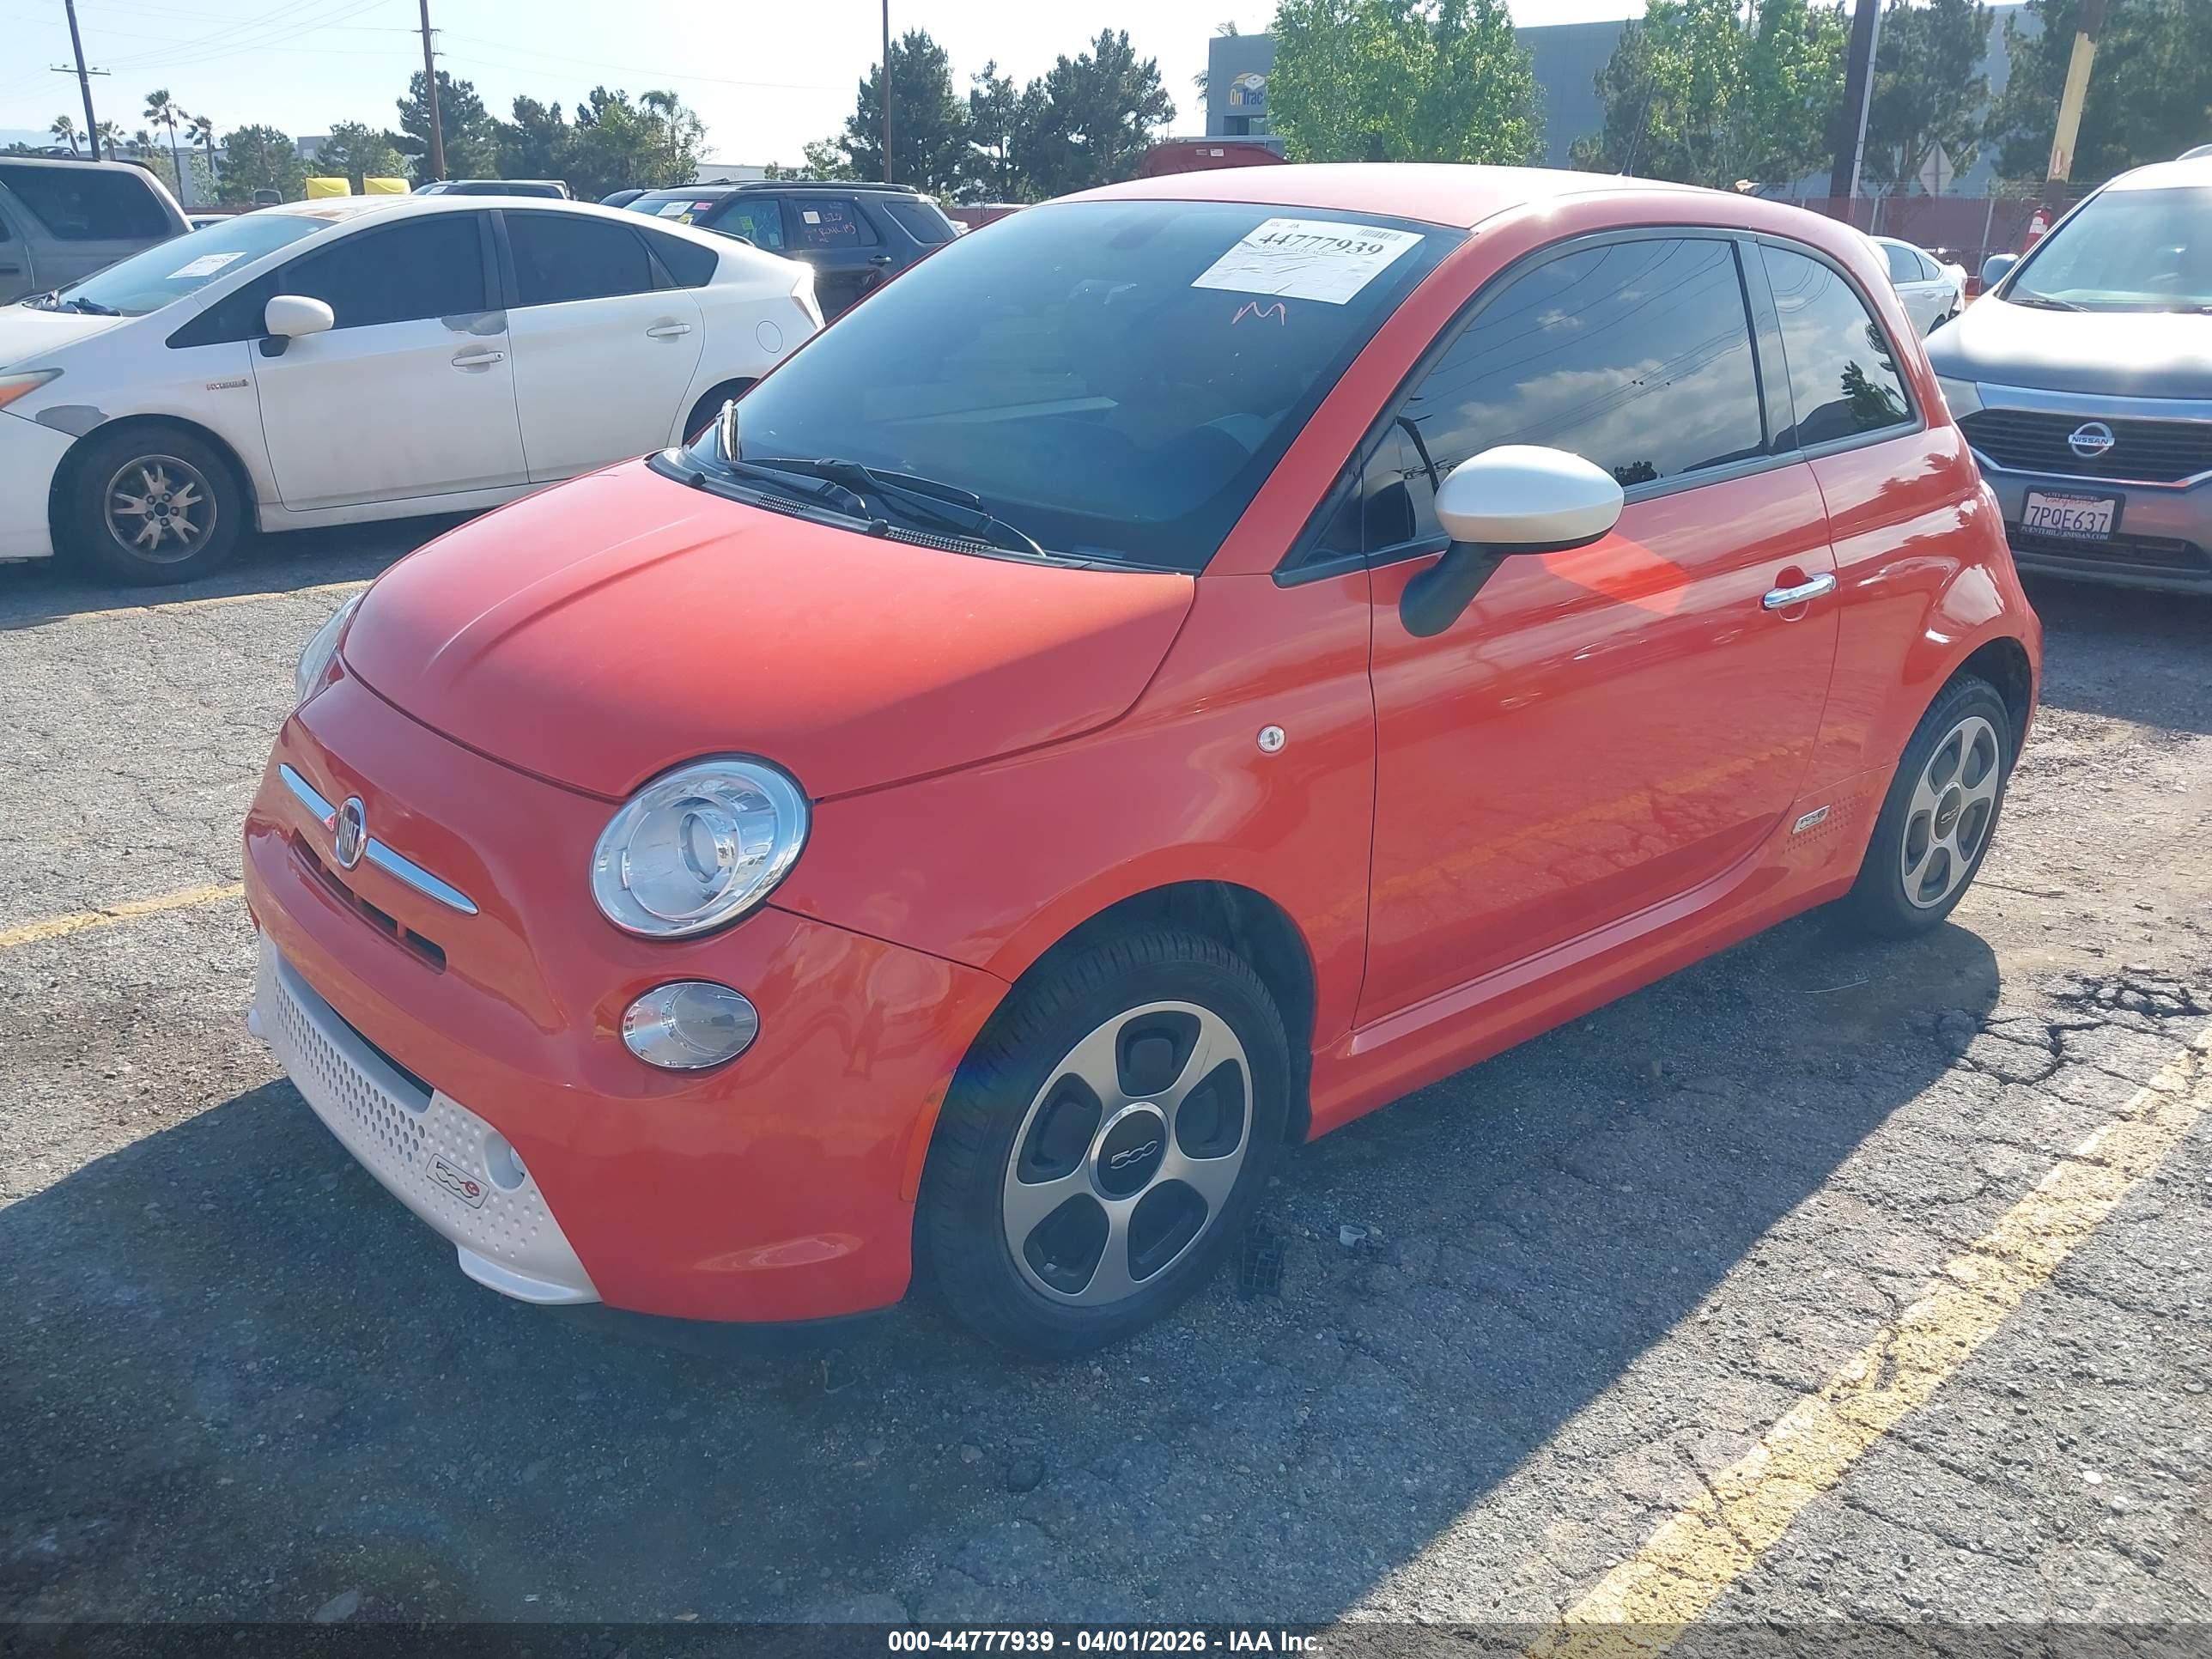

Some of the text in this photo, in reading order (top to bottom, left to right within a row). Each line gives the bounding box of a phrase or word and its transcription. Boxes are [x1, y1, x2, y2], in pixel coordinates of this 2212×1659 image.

[1230, 88, 1263, 106] OnTrac
[1259, 232, 1384, 256] 44777939
[2072, 435, 2109, 445] NISSAN
[2030, 506, 2108, 532] 7PQE637
[1110, 1139, 1158, 1170] 500
